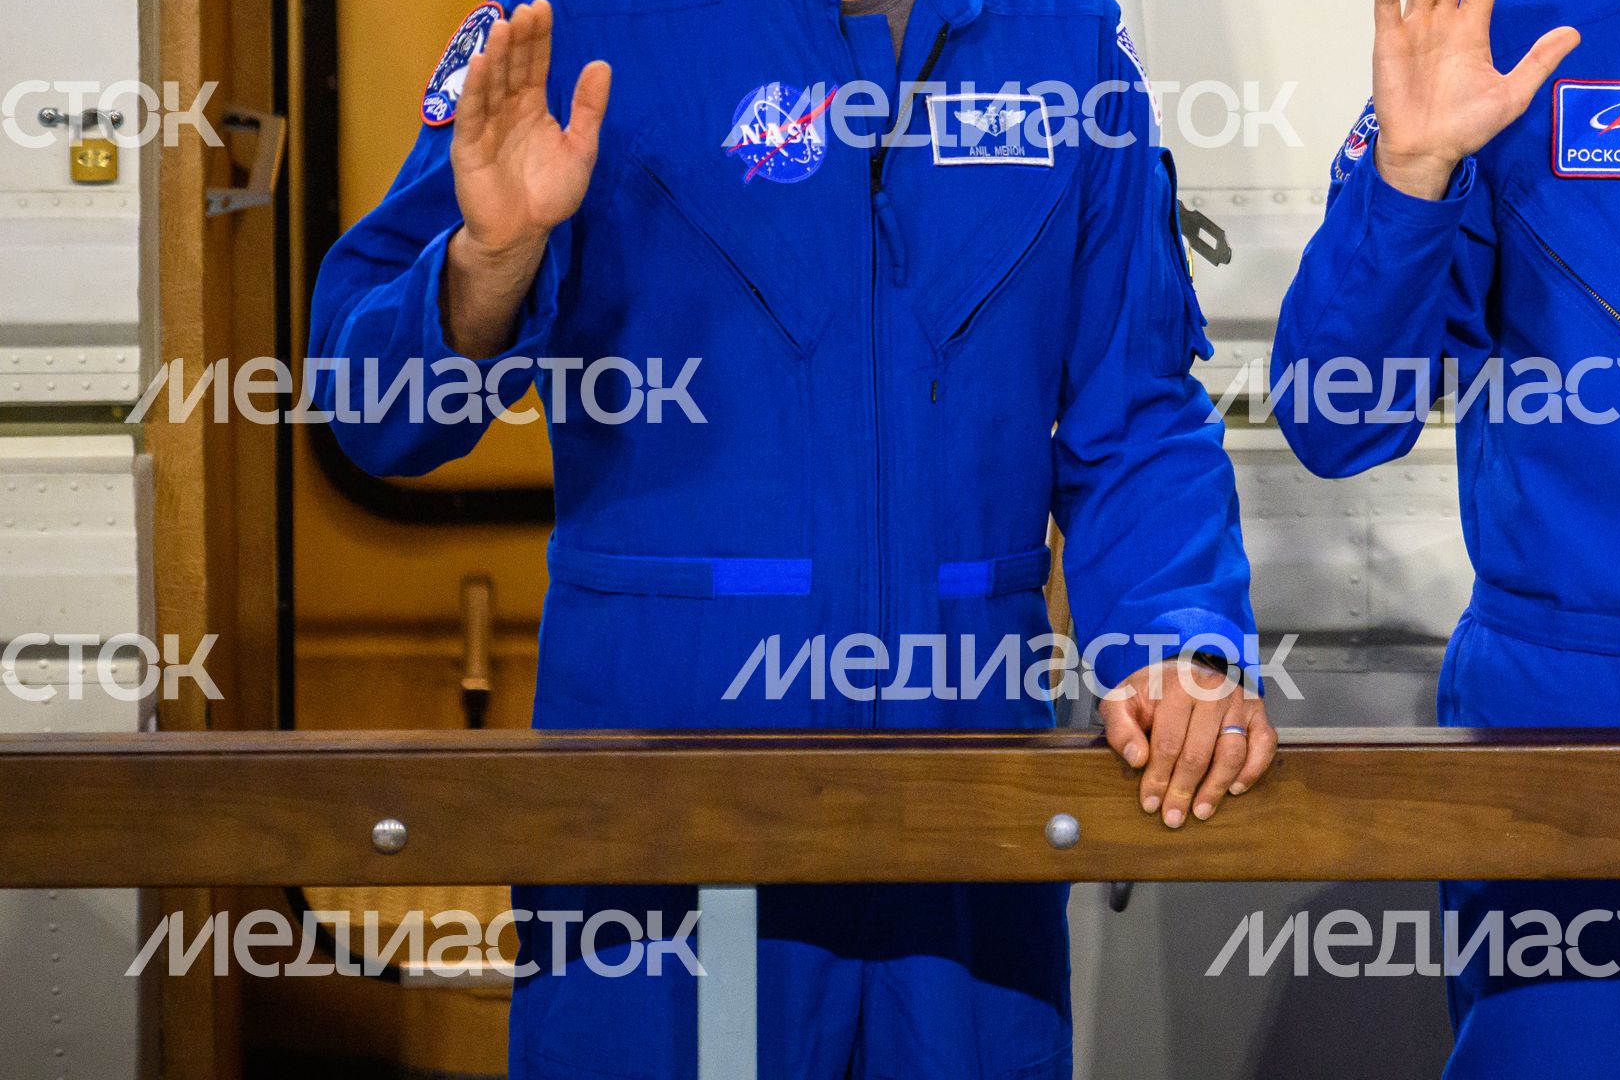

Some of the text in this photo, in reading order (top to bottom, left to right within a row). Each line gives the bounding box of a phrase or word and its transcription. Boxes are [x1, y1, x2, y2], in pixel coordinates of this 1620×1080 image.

[740, 122, 822, 147] NASA
[969, 146, 1025, 156] ANIL MENON
